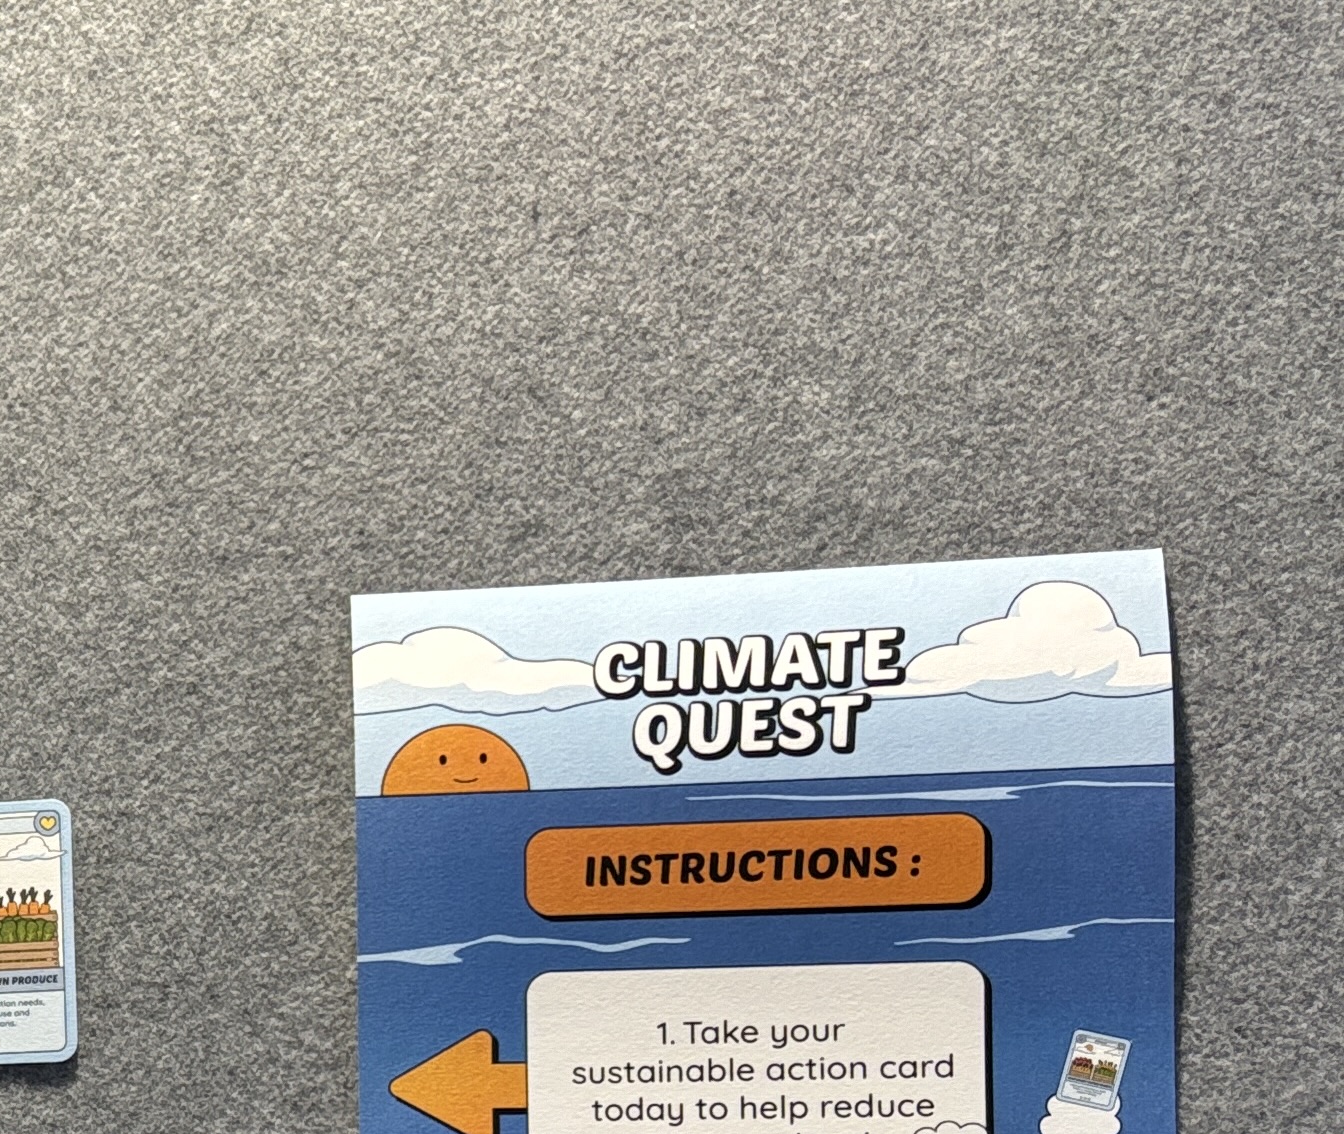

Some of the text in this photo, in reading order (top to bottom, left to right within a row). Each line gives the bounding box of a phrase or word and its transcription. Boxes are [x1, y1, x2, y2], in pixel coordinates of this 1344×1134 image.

[594, 628, 905, 699] CLIMATE
[633, 692, 871, 774] QUEST
[585, 846, 897, 886] INSTRUCTIONS
[12, 975, 58, 985] PRODUCE
[657, 1020, 845, 1049] 1. Take your
[572, 1054, 954, 1084] sustainable action card
[592, 1094, 935, 1126] today to help reduce
